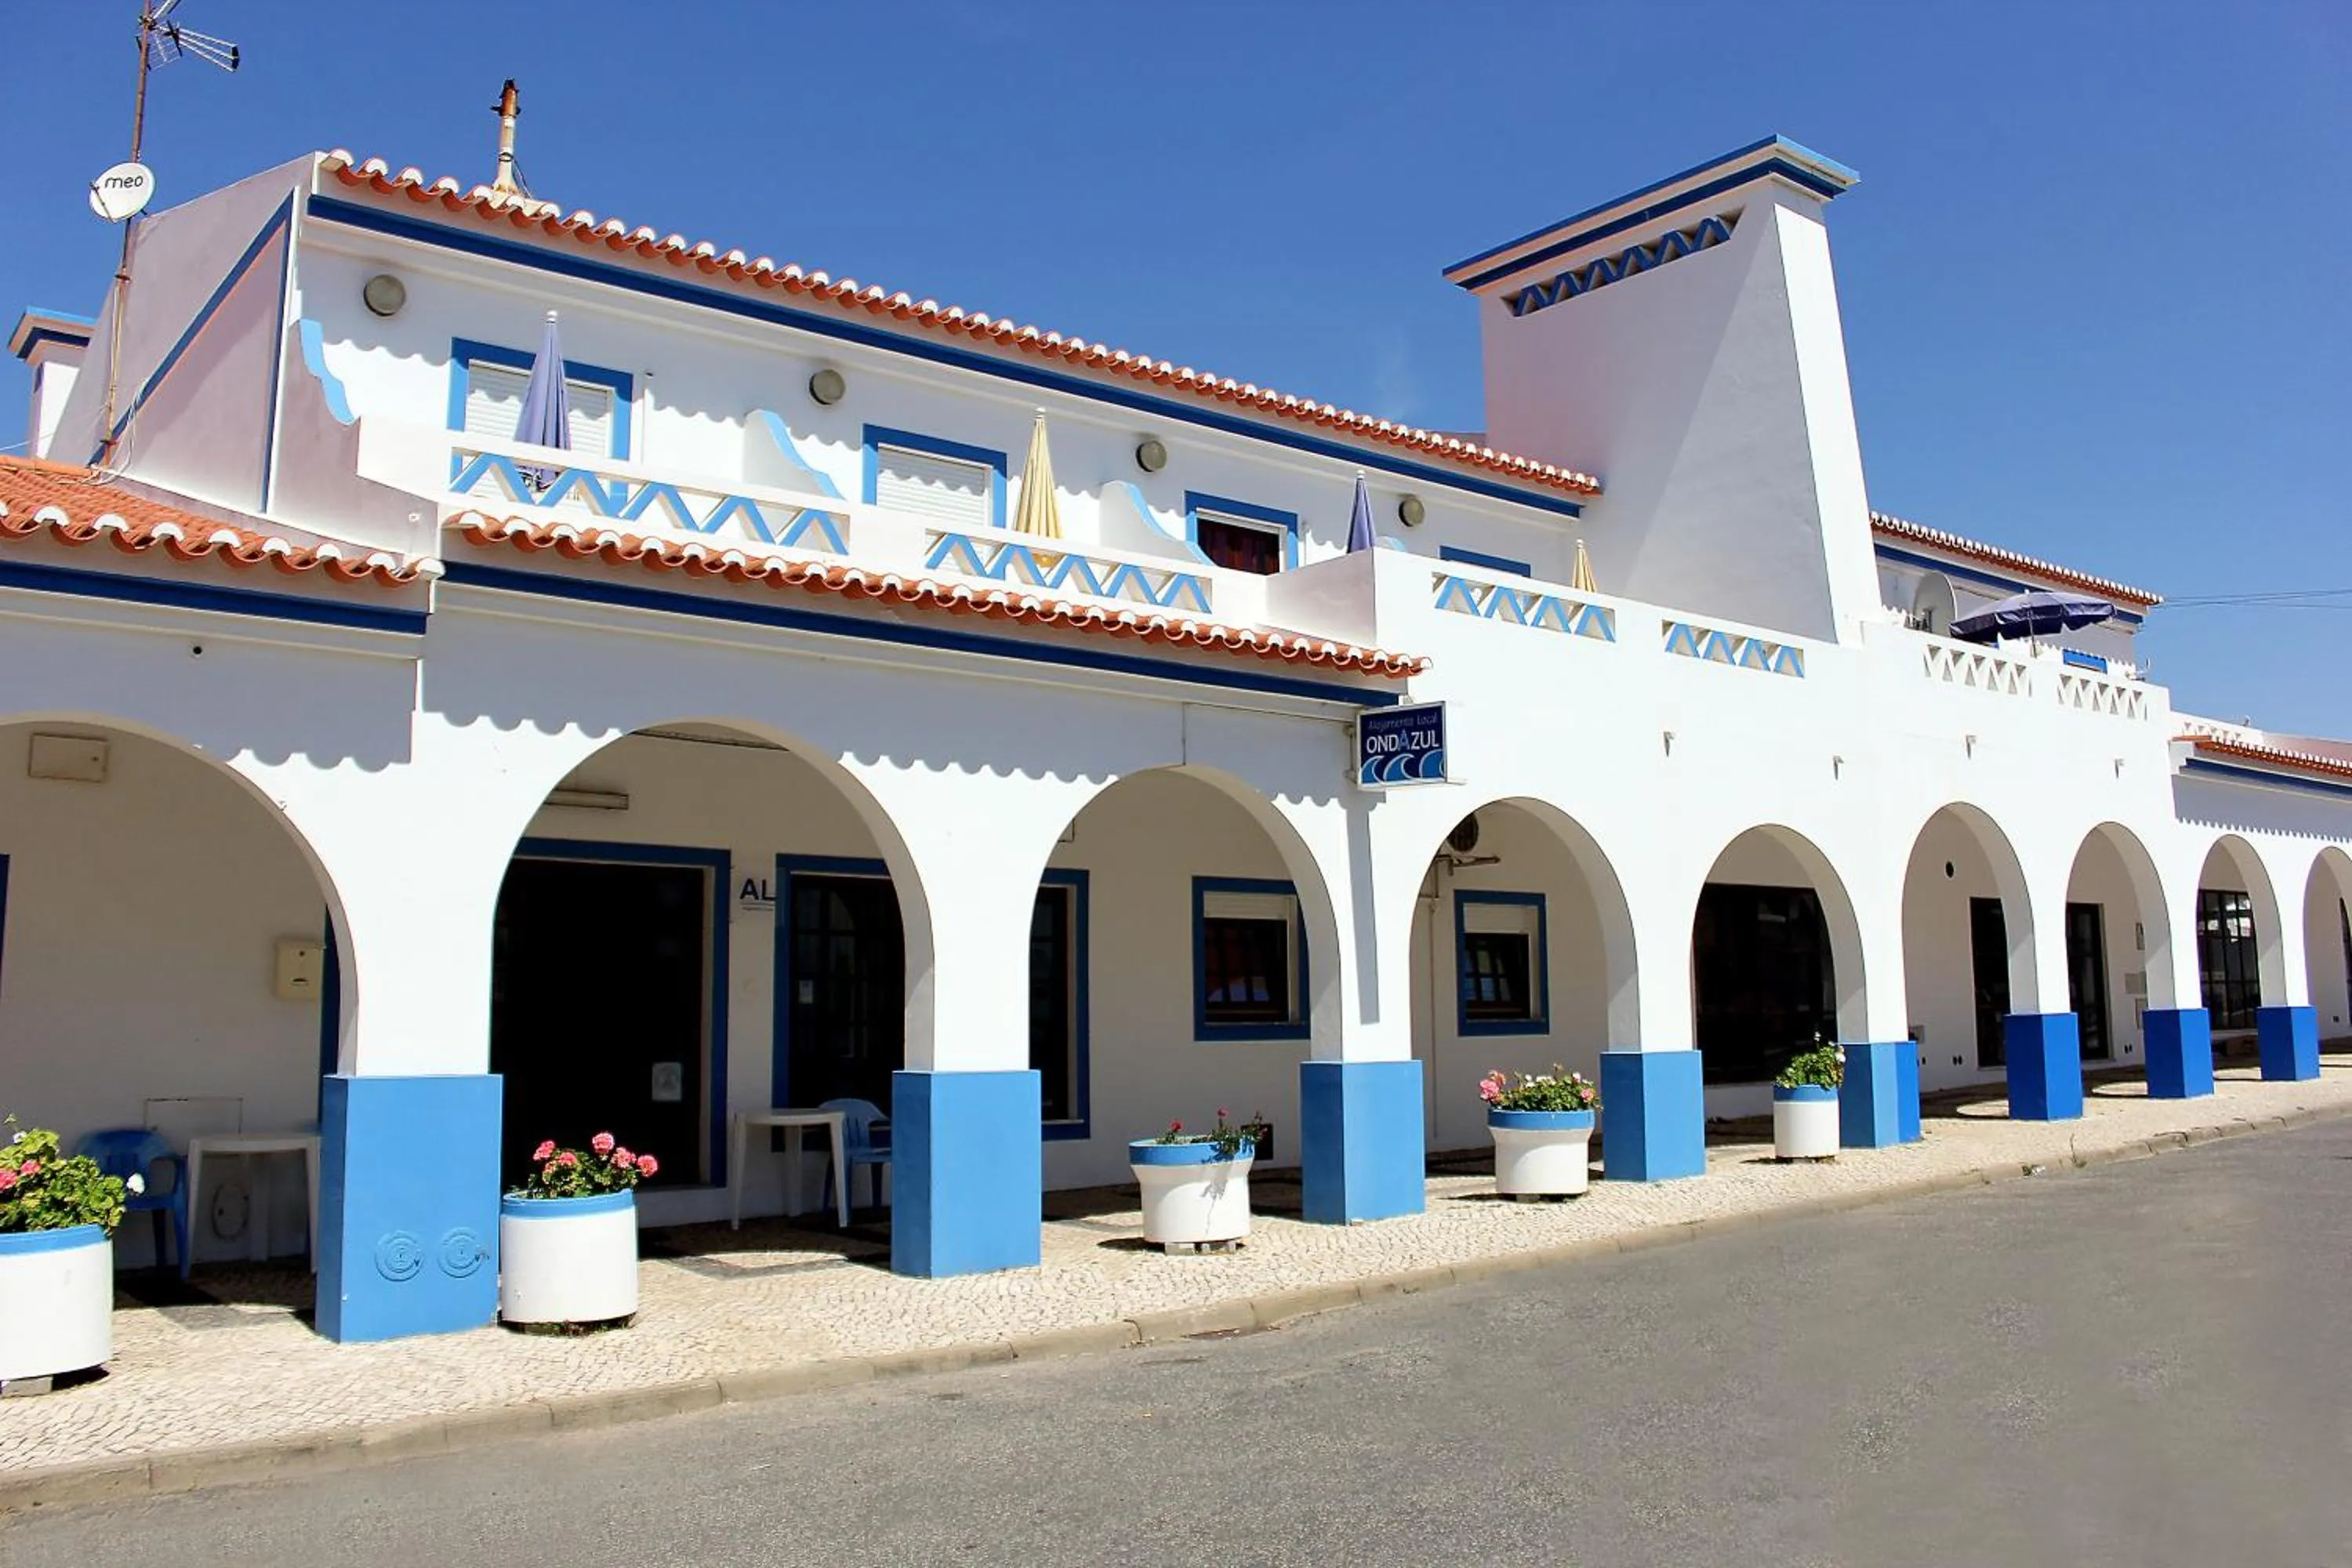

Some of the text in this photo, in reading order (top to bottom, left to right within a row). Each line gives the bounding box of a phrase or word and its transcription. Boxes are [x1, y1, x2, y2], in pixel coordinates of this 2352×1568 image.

[104, 175, 143, 189] meo
[1367, 728, 1440, 753] ONDAZUL
[739, 878, 776, 900] AL
